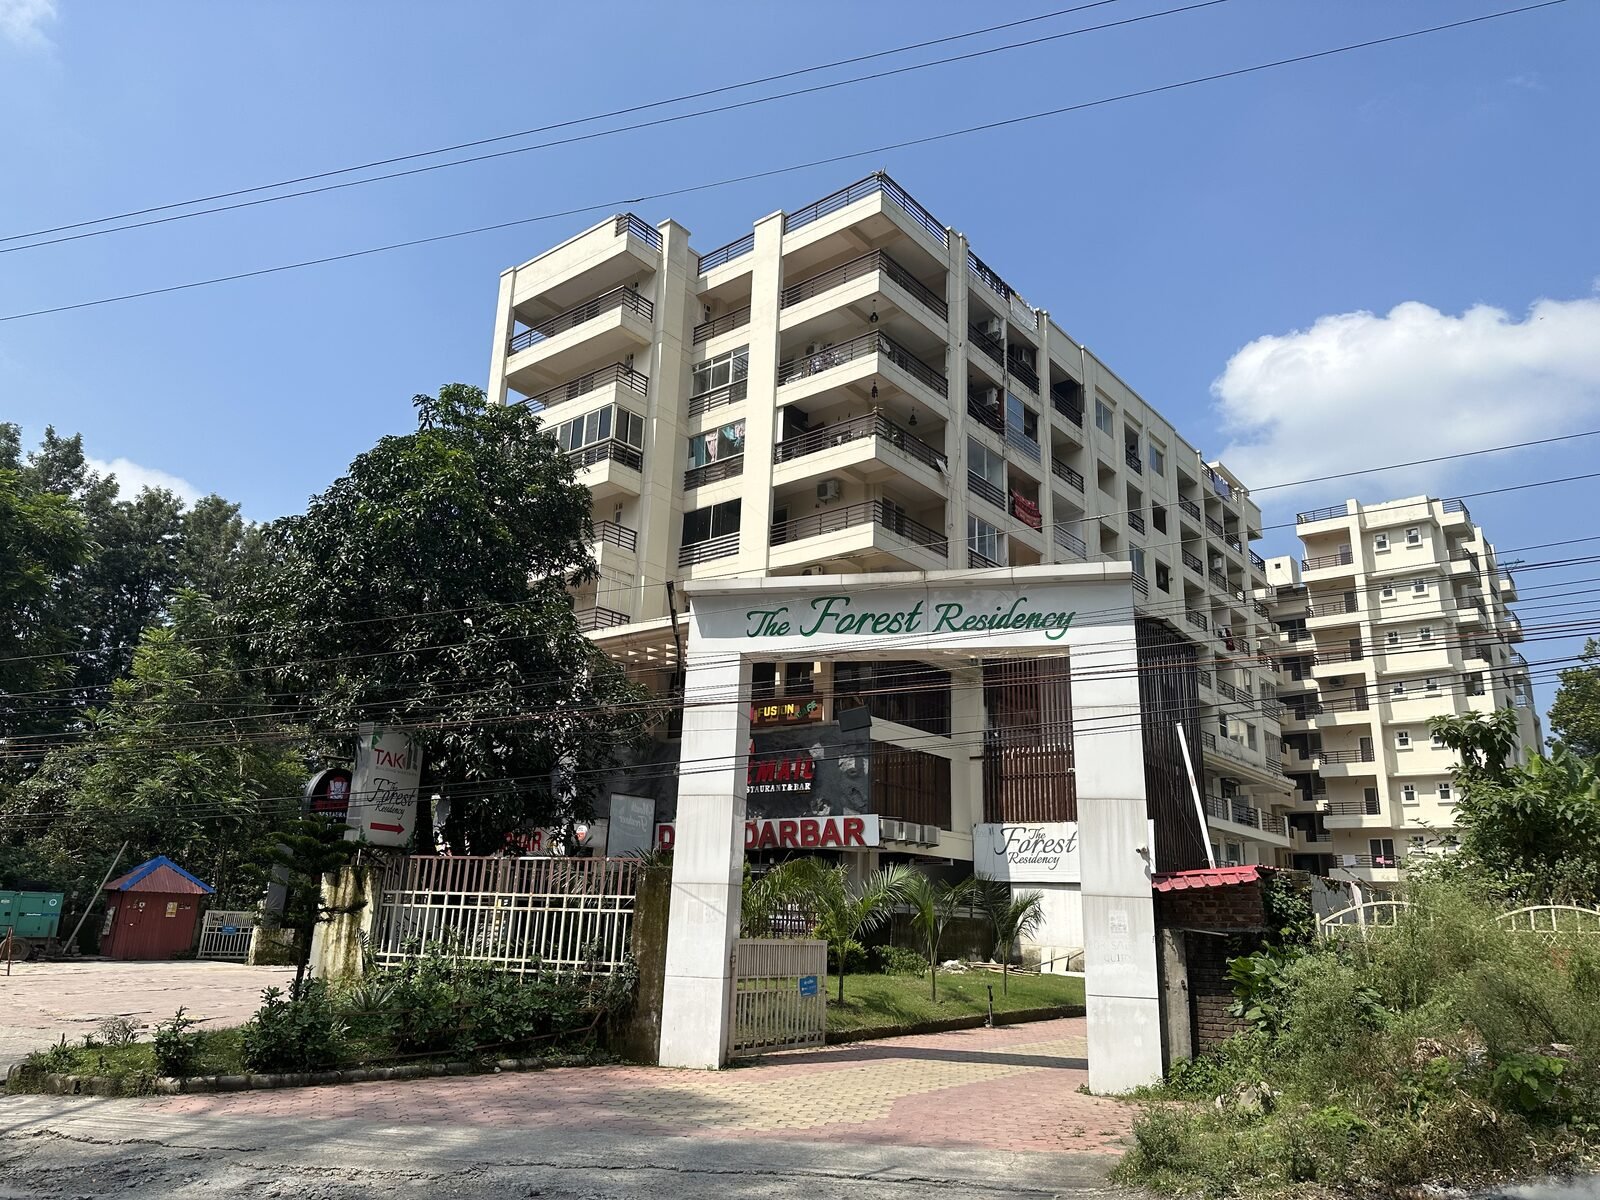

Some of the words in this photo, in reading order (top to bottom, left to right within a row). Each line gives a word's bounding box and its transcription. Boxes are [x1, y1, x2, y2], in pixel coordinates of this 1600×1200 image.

[746, 606, 790, 638] The
[799, 596, 925, 637] Forest
[932, 597, 1077, 640] Residency
[374, 748, 405, 770] TAK
[366, 777, 417, 807] Forest
[994, 827, 1078, 855] Forest
[1028, 827, 1047, 839] The
[1008, 851, 1061, 870] Residency
